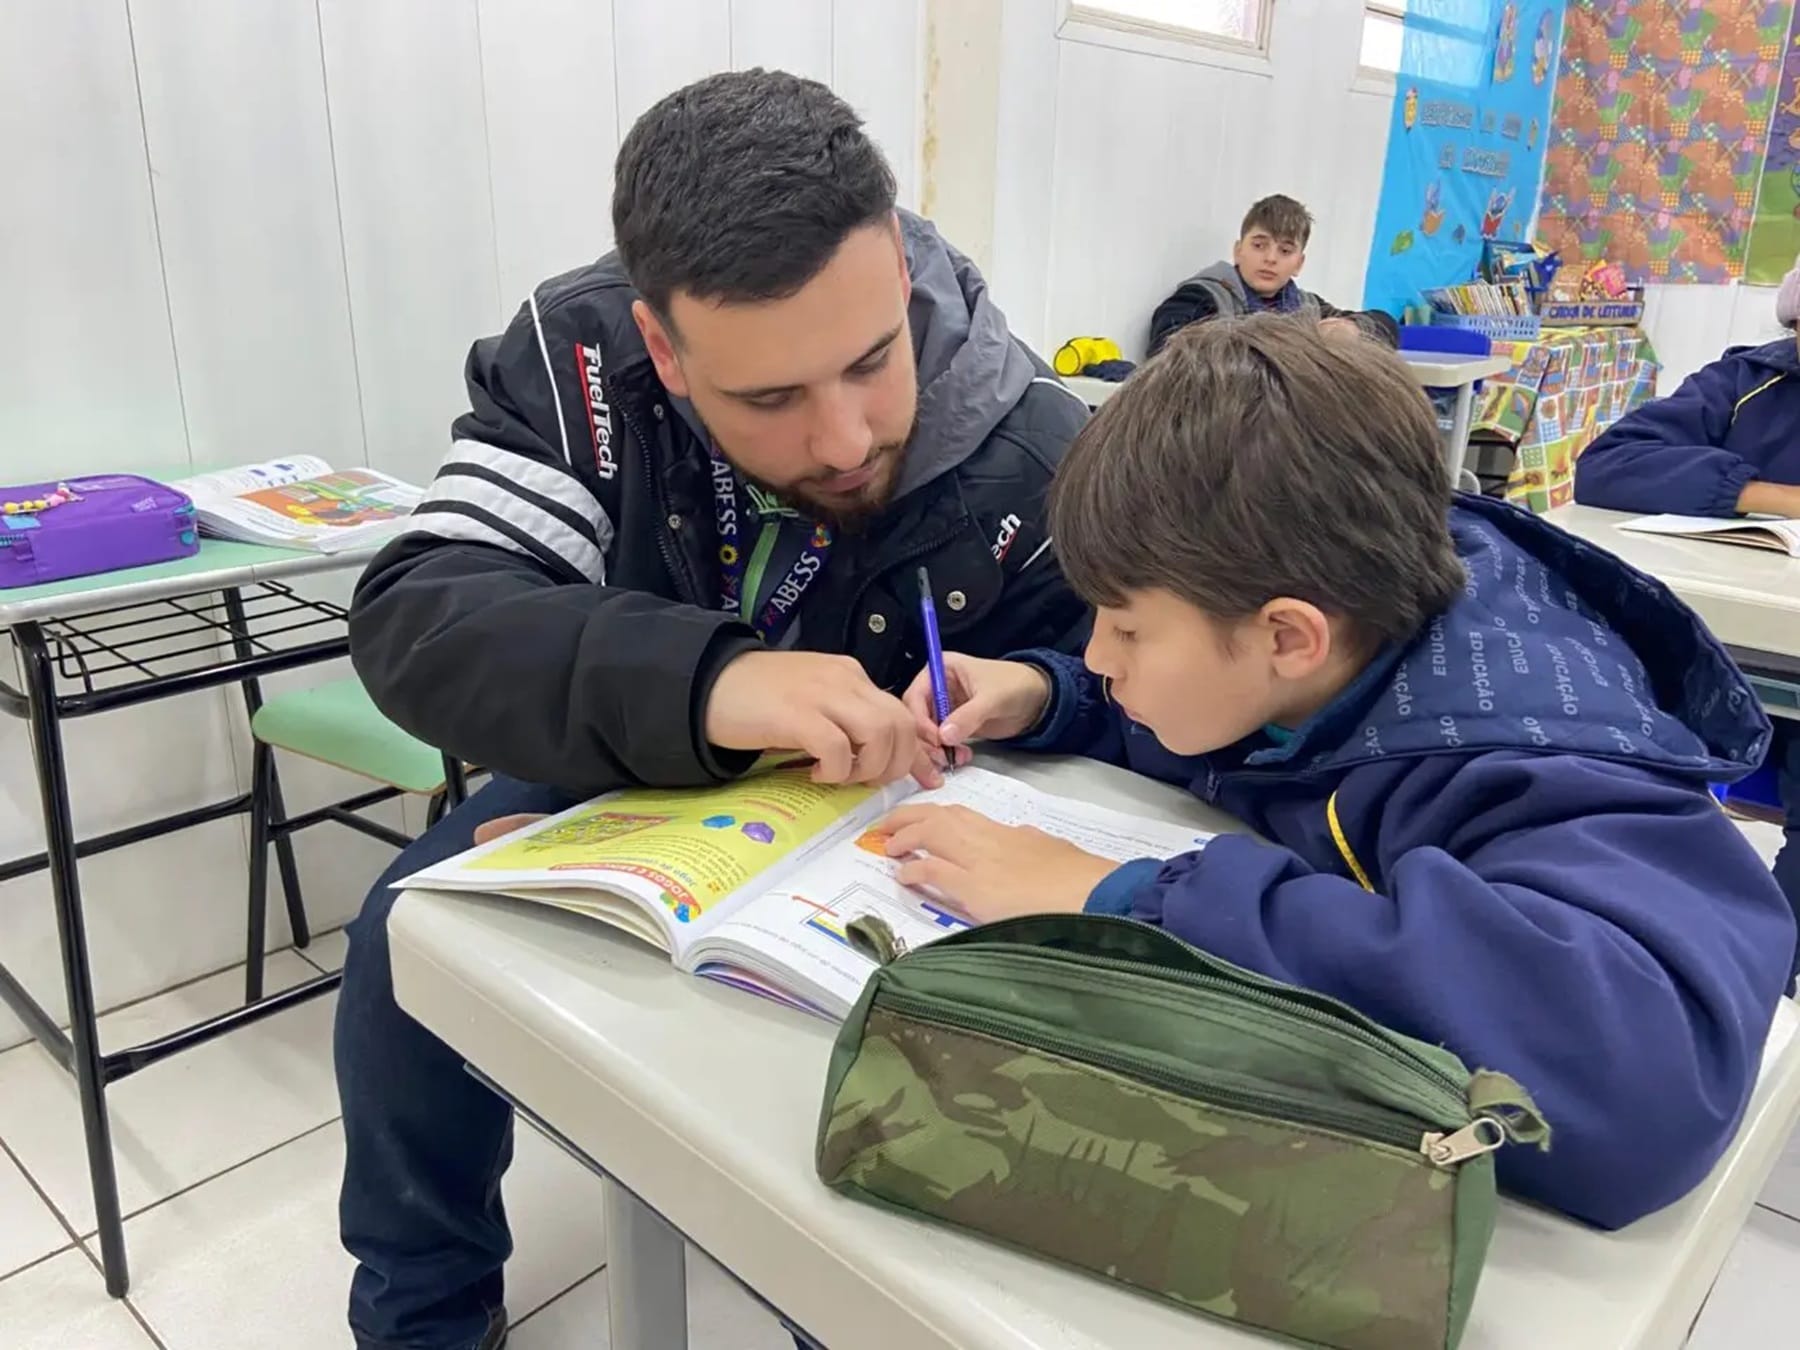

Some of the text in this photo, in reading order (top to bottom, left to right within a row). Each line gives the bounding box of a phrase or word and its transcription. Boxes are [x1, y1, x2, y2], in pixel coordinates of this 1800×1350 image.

[582, 343, 618, 480] FuelTech
[711, 460, 737, 536] ABESS
[770, 551, 821, 613] ABESS
[1469, 631, 1494, 711] EDUCAÇÃO
